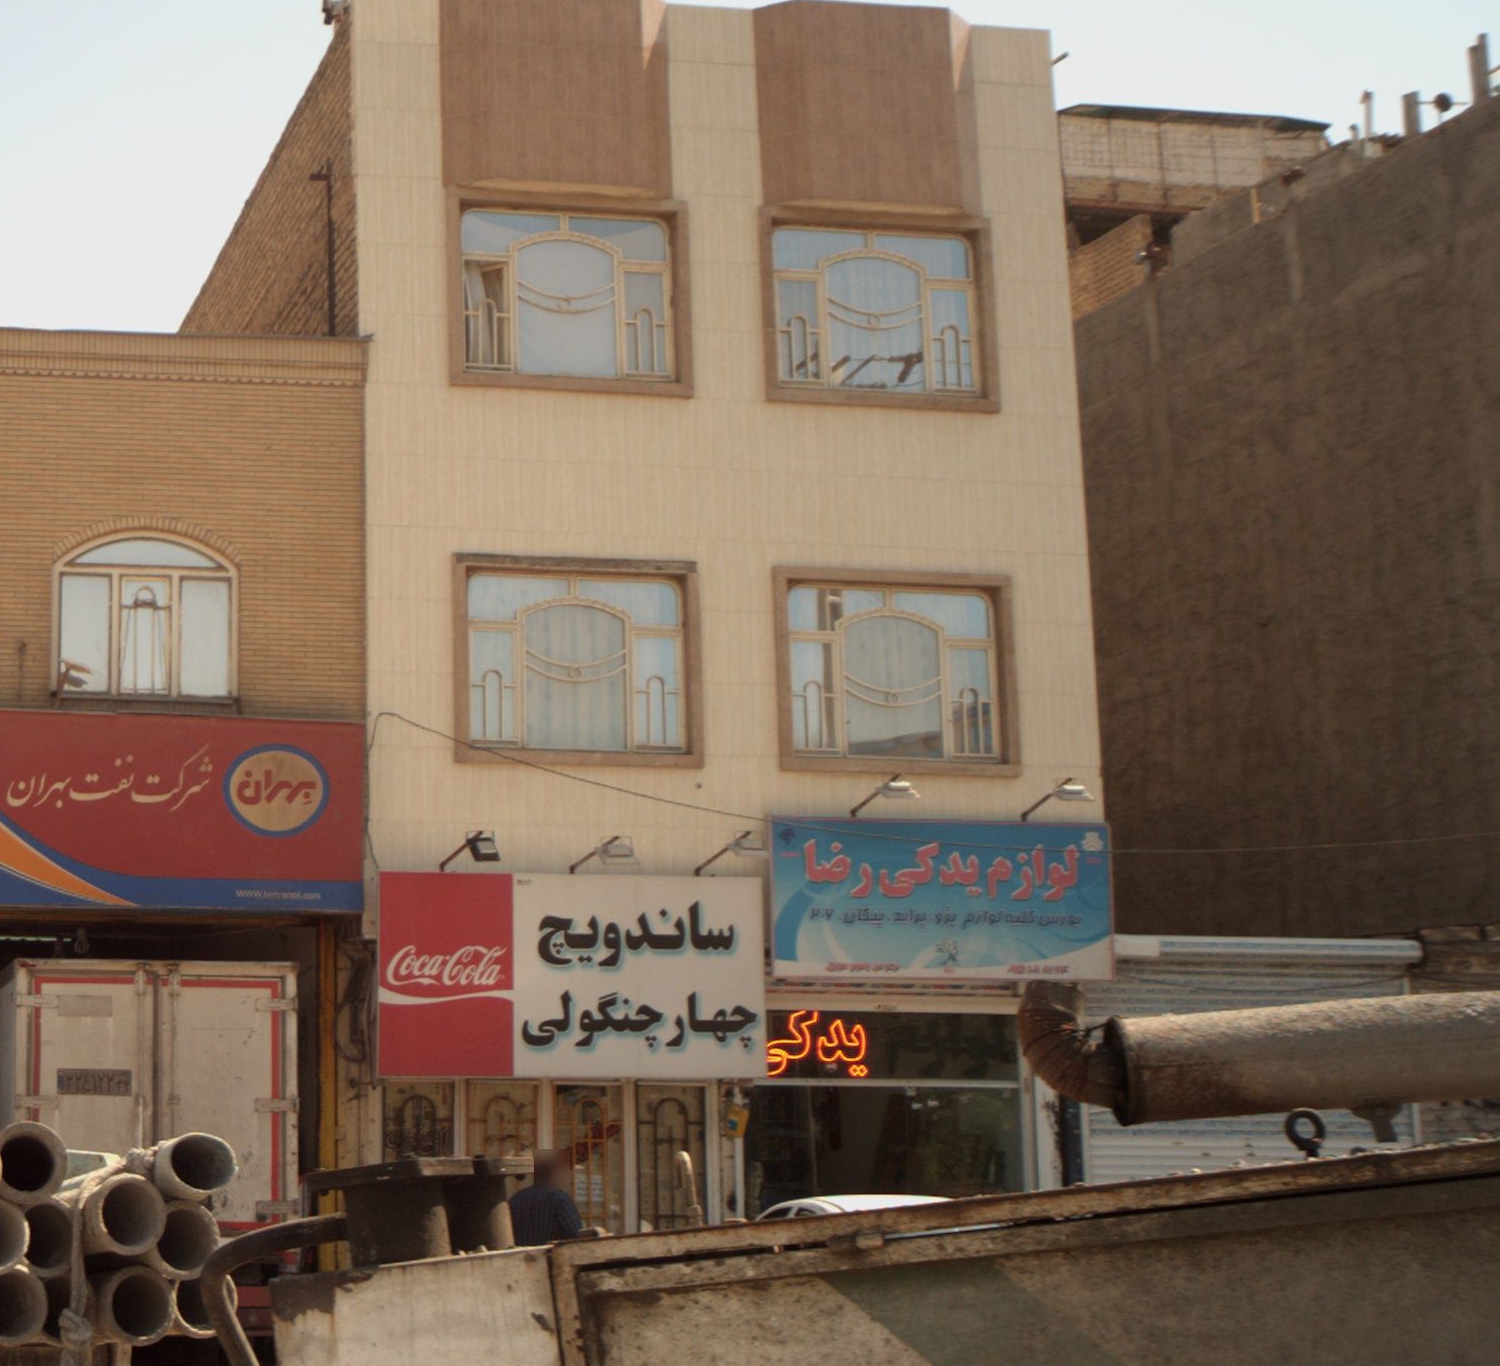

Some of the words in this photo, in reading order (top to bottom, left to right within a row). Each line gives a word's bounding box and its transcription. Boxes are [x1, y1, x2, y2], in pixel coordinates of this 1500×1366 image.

[6, 772, 72, 809] بهران
[69, 754, 136, 801] نفت
[131, 743, 214, 813] شرکت
[803, 838, 873, 898] رضا
[879, 841, 982, 898] یدکی
[986, 843, 1080, 901] لوازم
[537, 901, 735, 968] ساندویچ
[386, 944, 507, 987] Coca-Cola
